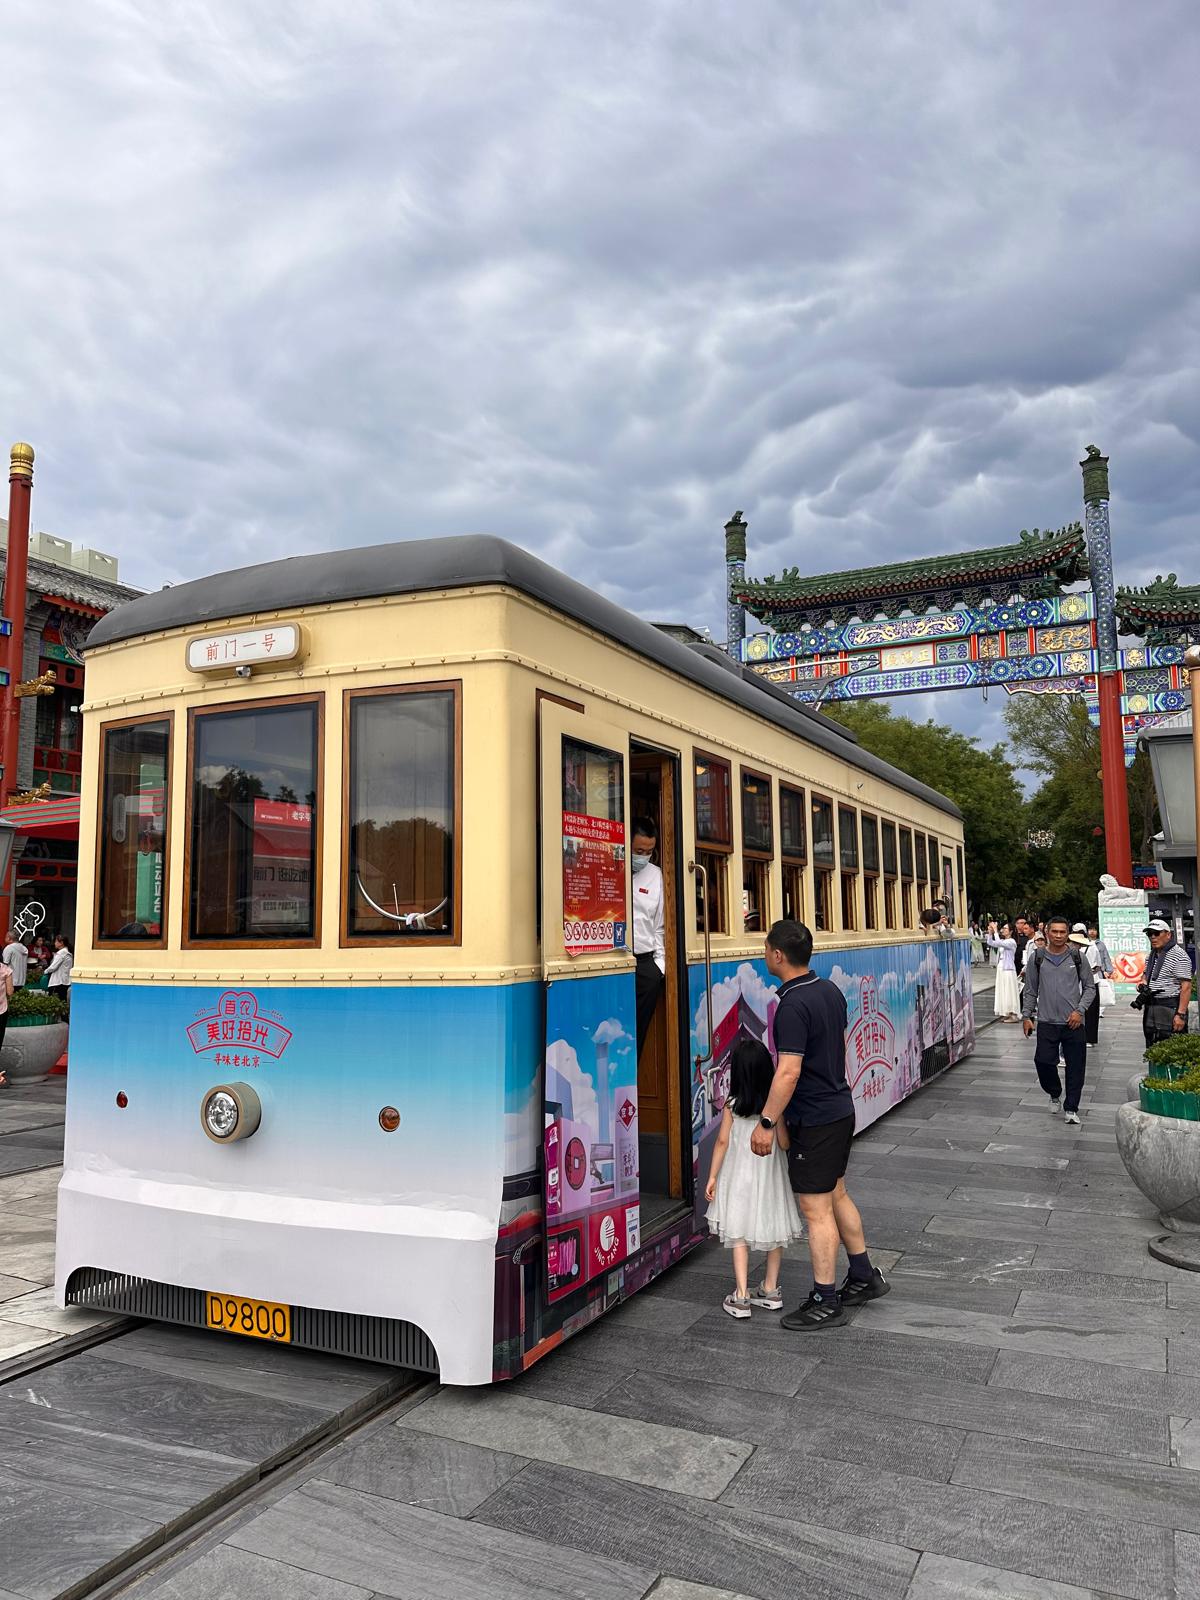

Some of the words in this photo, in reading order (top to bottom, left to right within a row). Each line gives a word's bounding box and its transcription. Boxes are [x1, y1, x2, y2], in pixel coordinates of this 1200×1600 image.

[205, 632, 277, 661] 前门一号
[1102, 922, 1146, 937] 老字号
[1102, 936, 1147, 951] 新体验
[224, 999, 251, 1016] 首农
[206, 1019, 269, 1047] 美好拾光
[213, 1052, 261, 1068] 寻味老北京
[593, 1246, 605, 1265] JING
[606, 1236, 619, 1264] TANG
[210, 1295, 287, 1338] D9800
